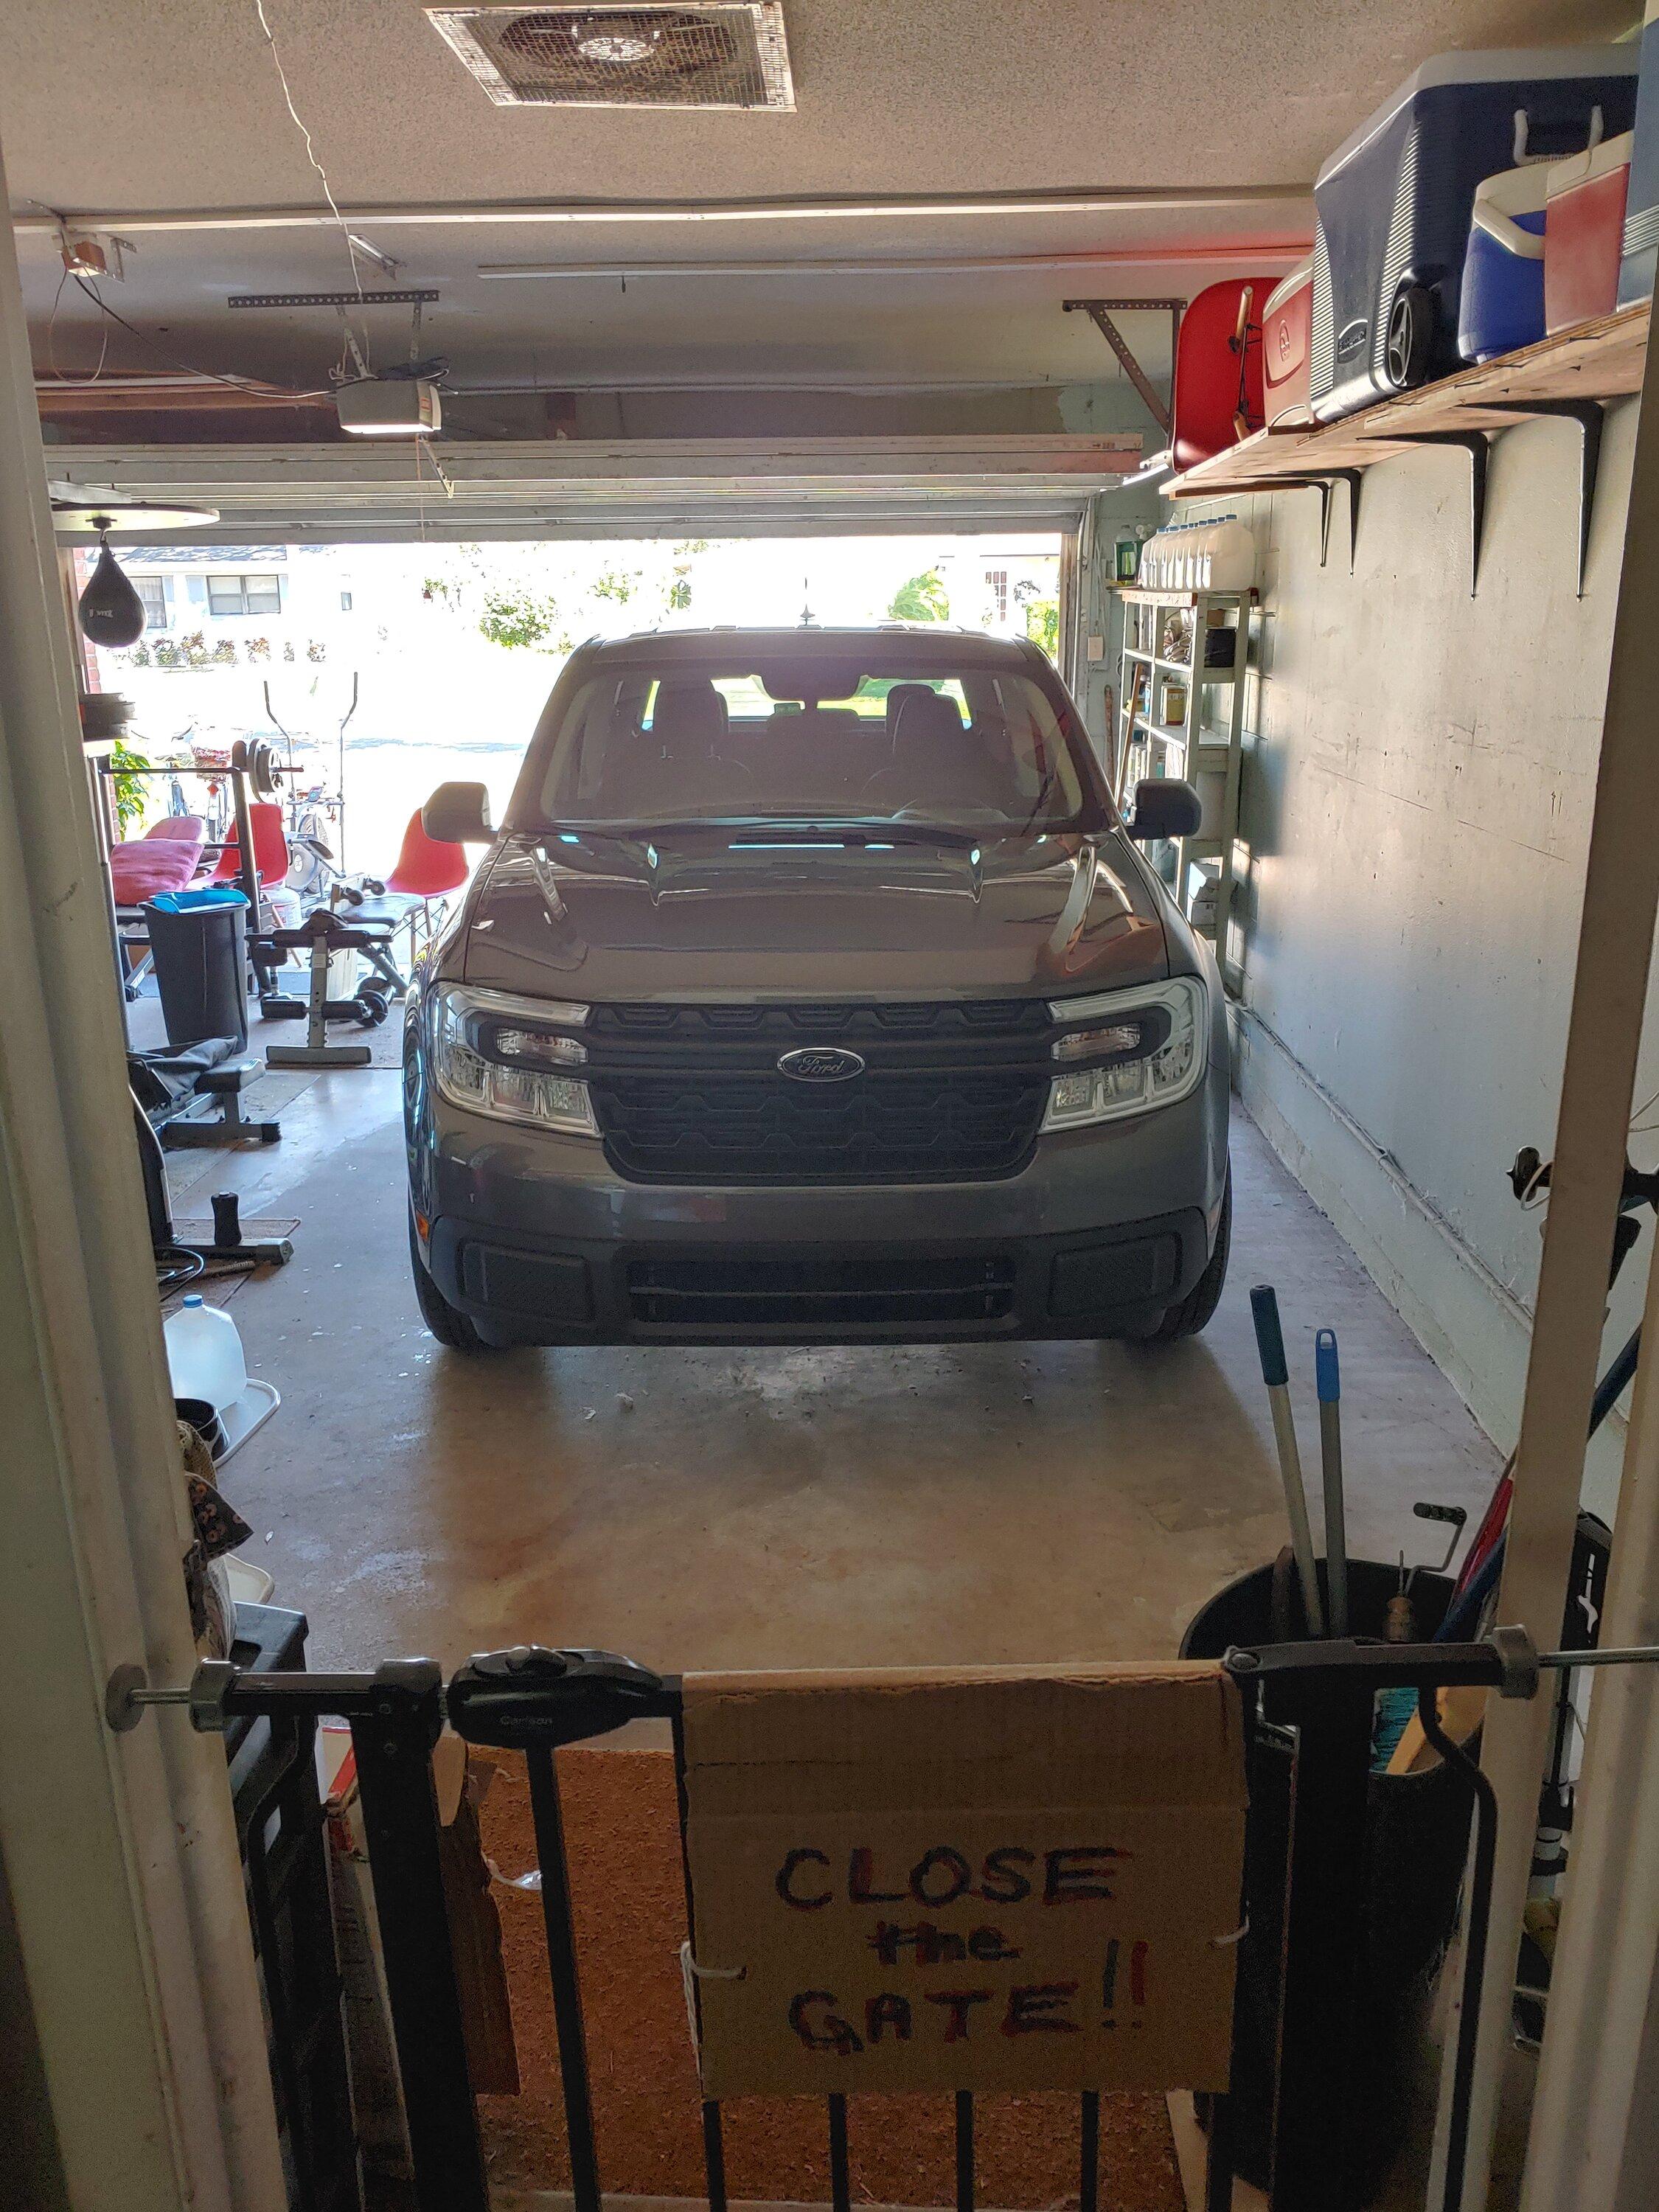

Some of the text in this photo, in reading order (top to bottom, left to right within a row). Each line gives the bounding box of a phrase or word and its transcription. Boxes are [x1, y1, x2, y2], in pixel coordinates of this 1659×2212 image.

[798, 1055, 845, 1074] Ford
[775, 1846, 1133, 1911] CLOSE
[865, 1921, 1023, 1967] the
